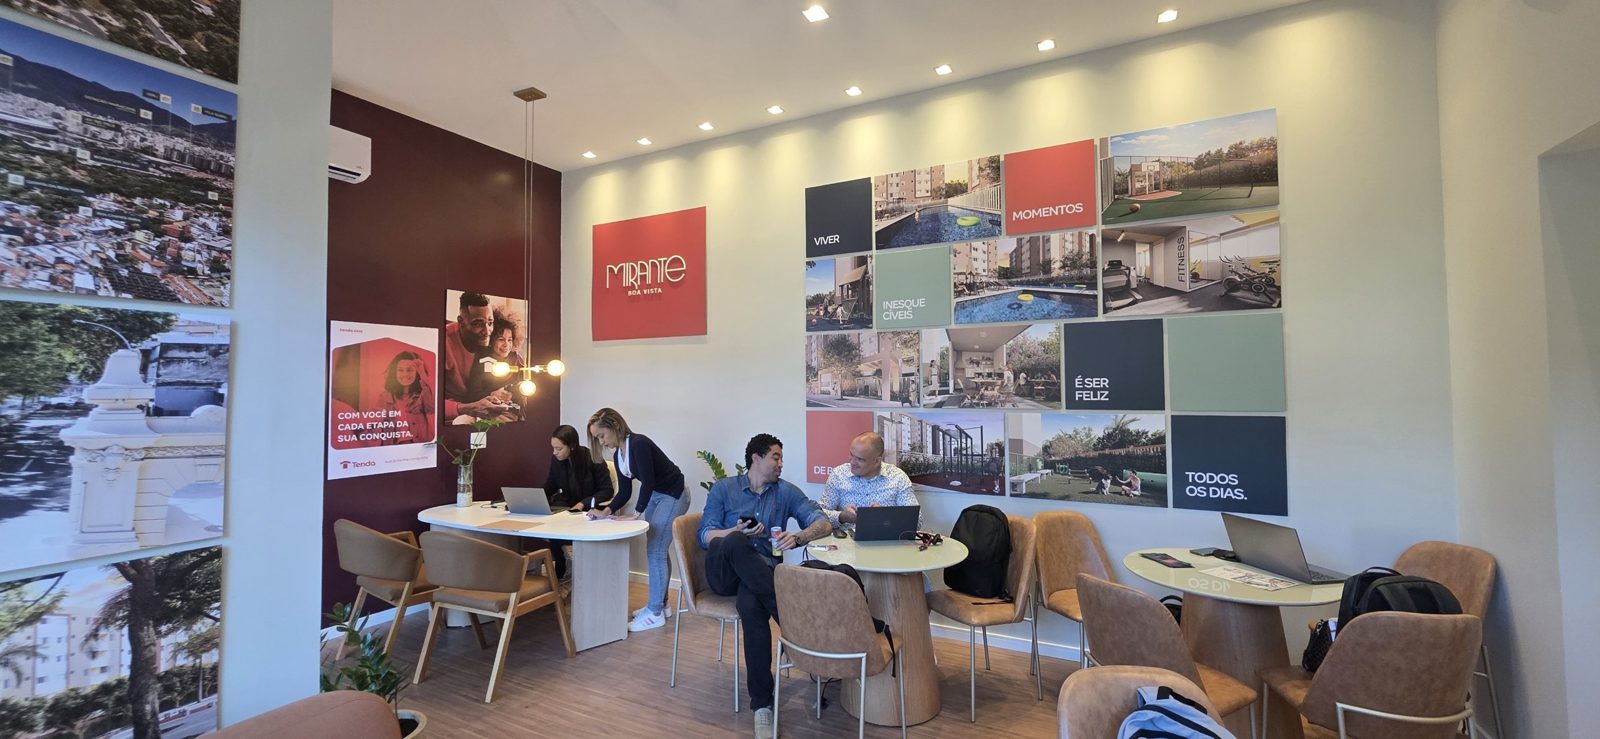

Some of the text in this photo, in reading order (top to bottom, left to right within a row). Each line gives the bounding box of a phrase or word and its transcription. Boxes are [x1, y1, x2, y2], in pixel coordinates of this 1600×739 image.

[1012, 202, 1084, 221] MOMENTOS
[814, 234, 840, 246] VIVER
[1177, 236, 1186, 283] FITNESS
[643, 287, 662, 295] VISTA
[882, 298, 927, 310] INESQUE
[882, 309, 913, 320] CÍVEIS
[1075, 375, 1109, 388] É SER
[1075, 390, 1109, 401] FELIZ
[337, 409, 402, 420] COM VOCÊ EM
[337, 420, 409, 431] CADA ETAPA DA
[337, 430, 413, 442] SUA CONQUISTA.
[813, 465, 826, 475] DE
[1184, 471, 1239, 485] TODOS
[1185, 485, 1248, 500] OS DIAS.
